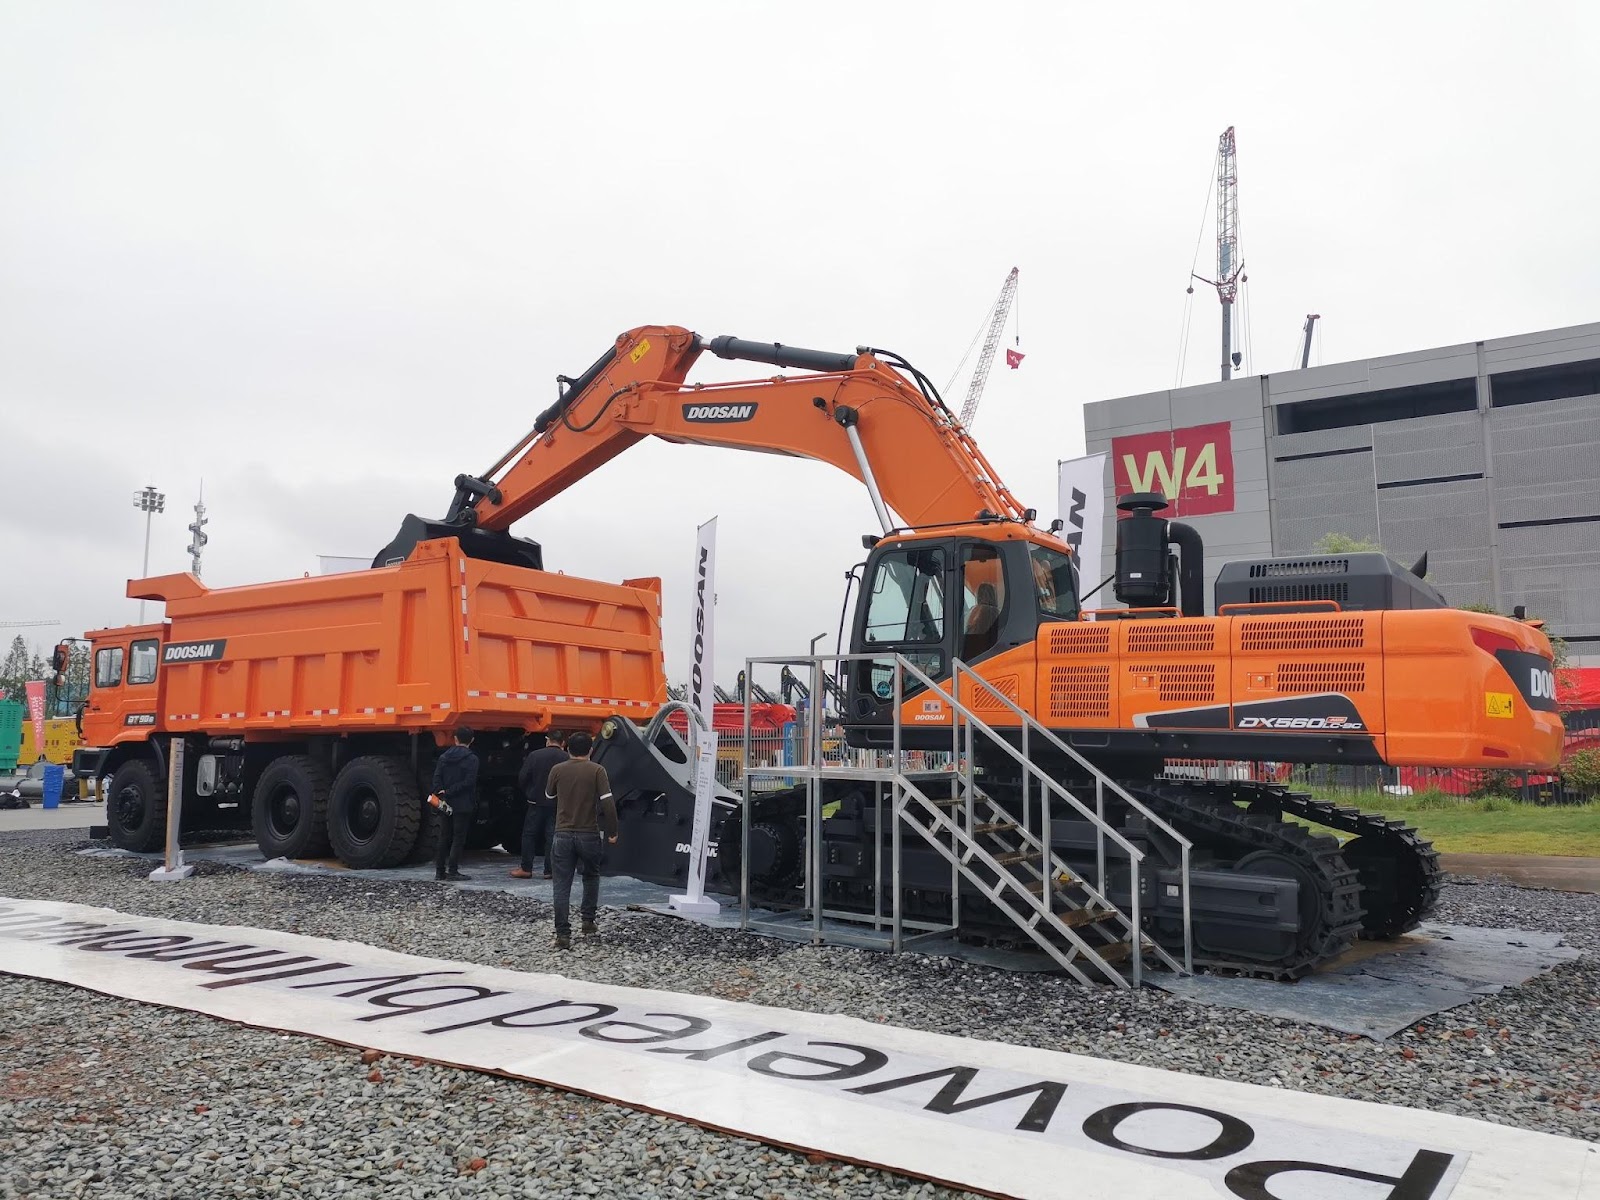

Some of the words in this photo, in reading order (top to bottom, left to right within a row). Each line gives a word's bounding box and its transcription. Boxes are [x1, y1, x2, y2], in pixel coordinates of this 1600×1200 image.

[687, 406, 752, 419] DOOSAN
[1122, 443, 1224, 500] W4
[165, 644, 215, 660] DOOSAN
[288, 972, 511, 1023] by
[422, 999, 1454, 1200] Powered
